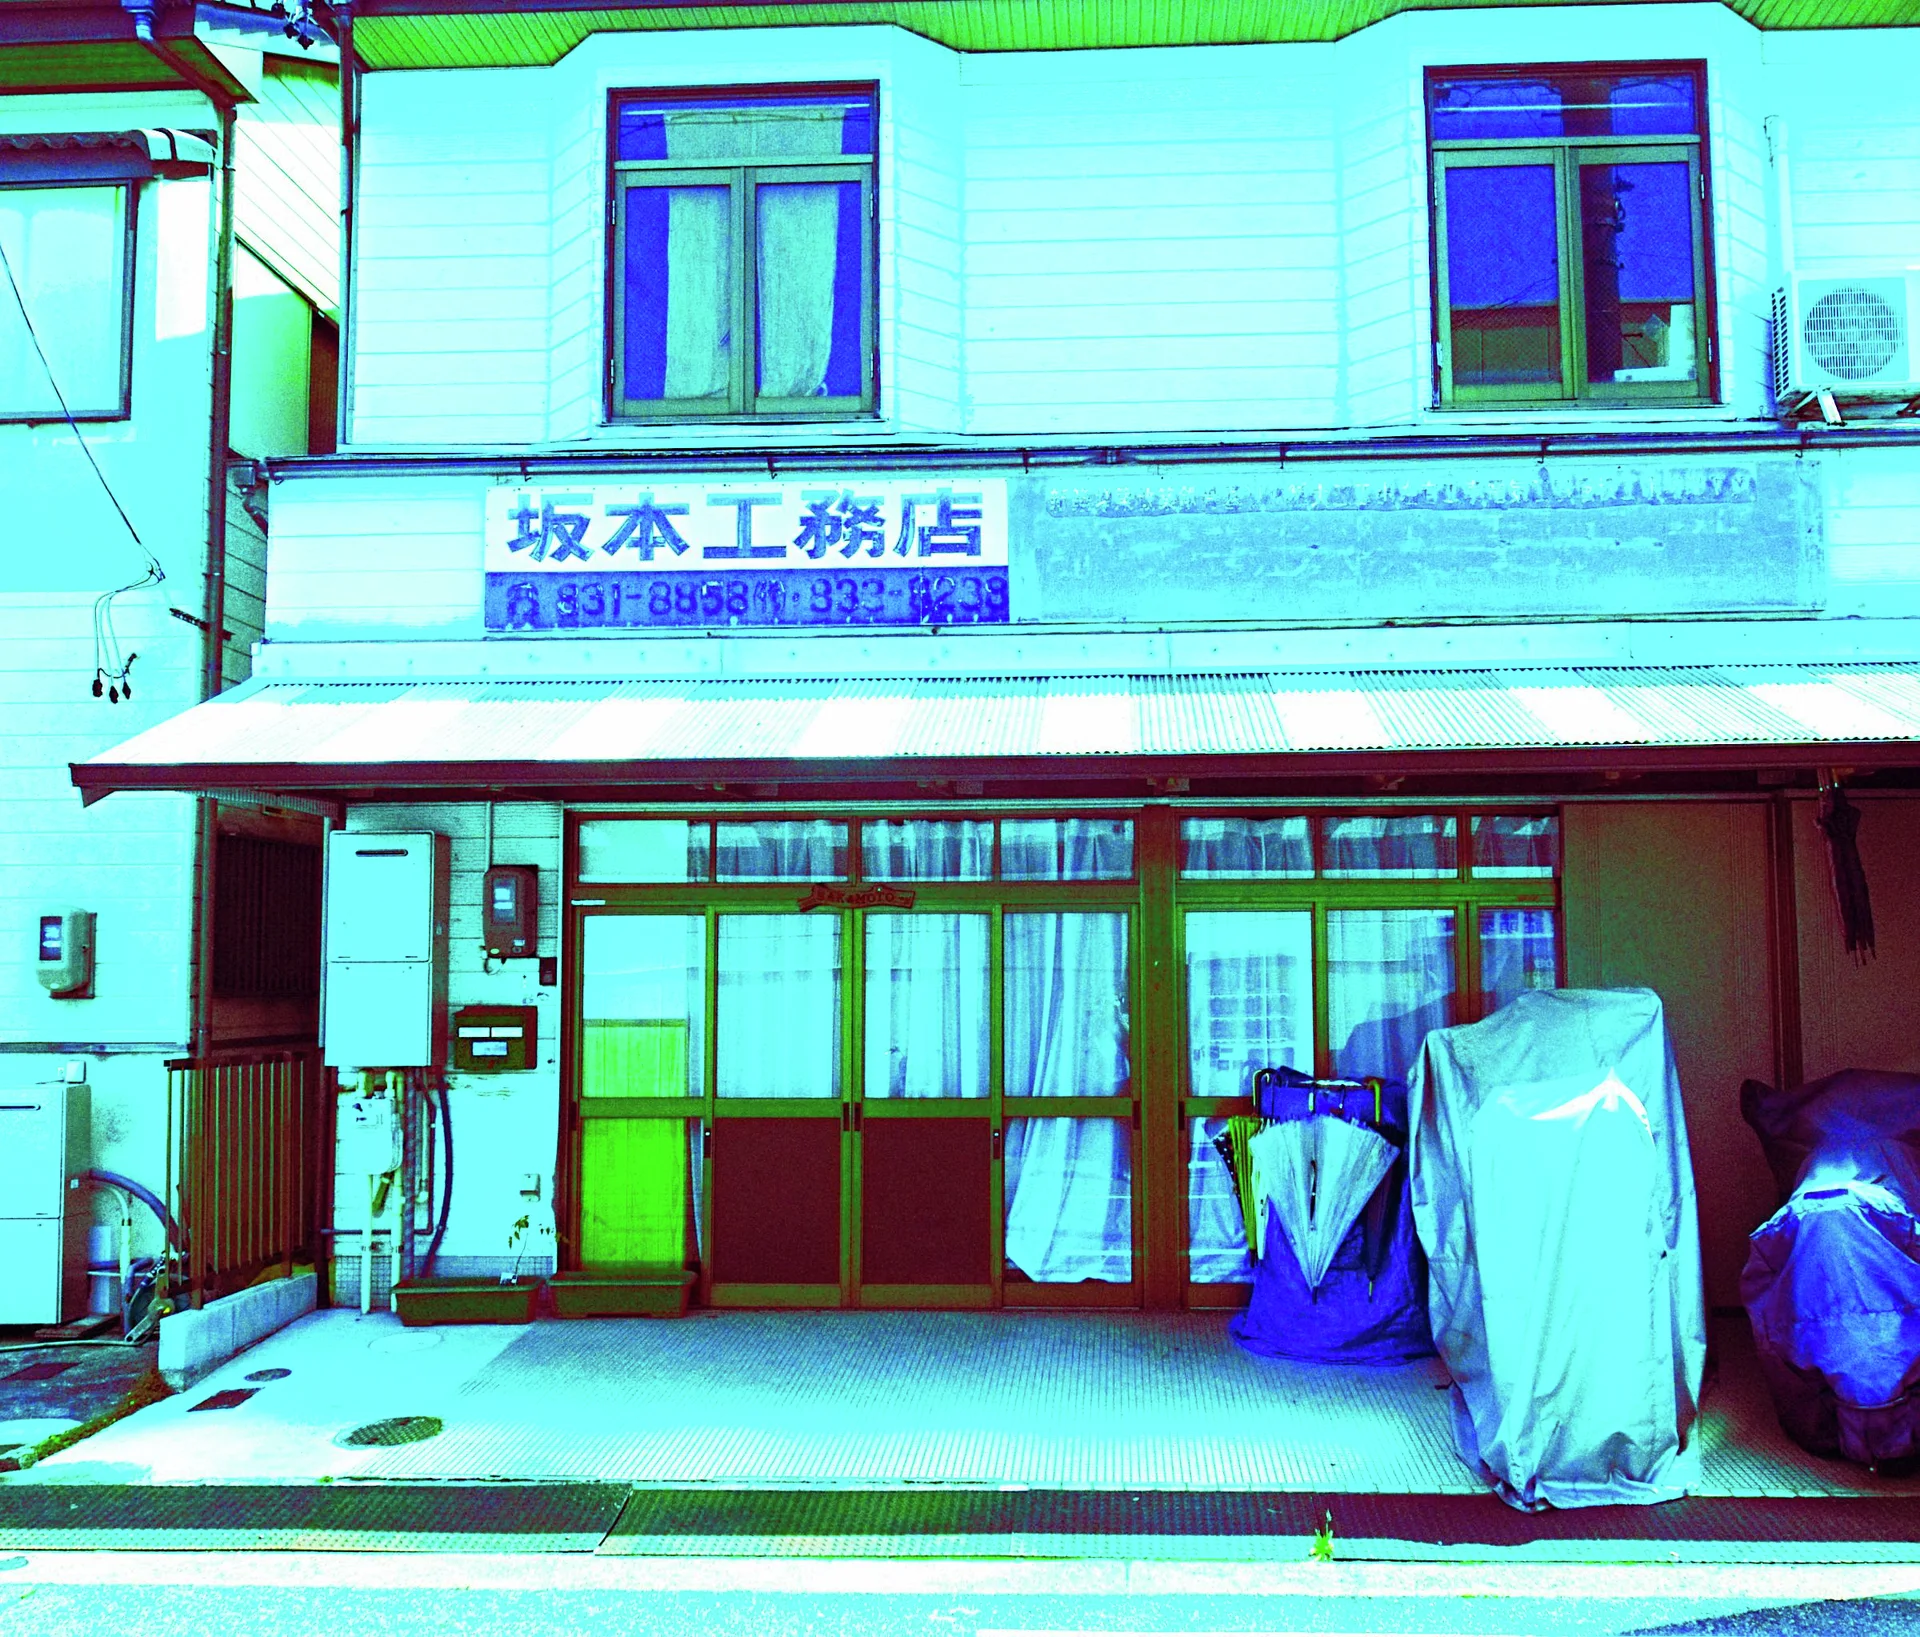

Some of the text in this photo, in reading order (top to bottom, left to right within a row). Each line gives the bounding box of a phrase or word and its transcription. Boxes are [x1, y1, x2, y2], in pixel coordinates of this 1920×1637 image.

[507, 487, 983, 562] 坂本工務店
